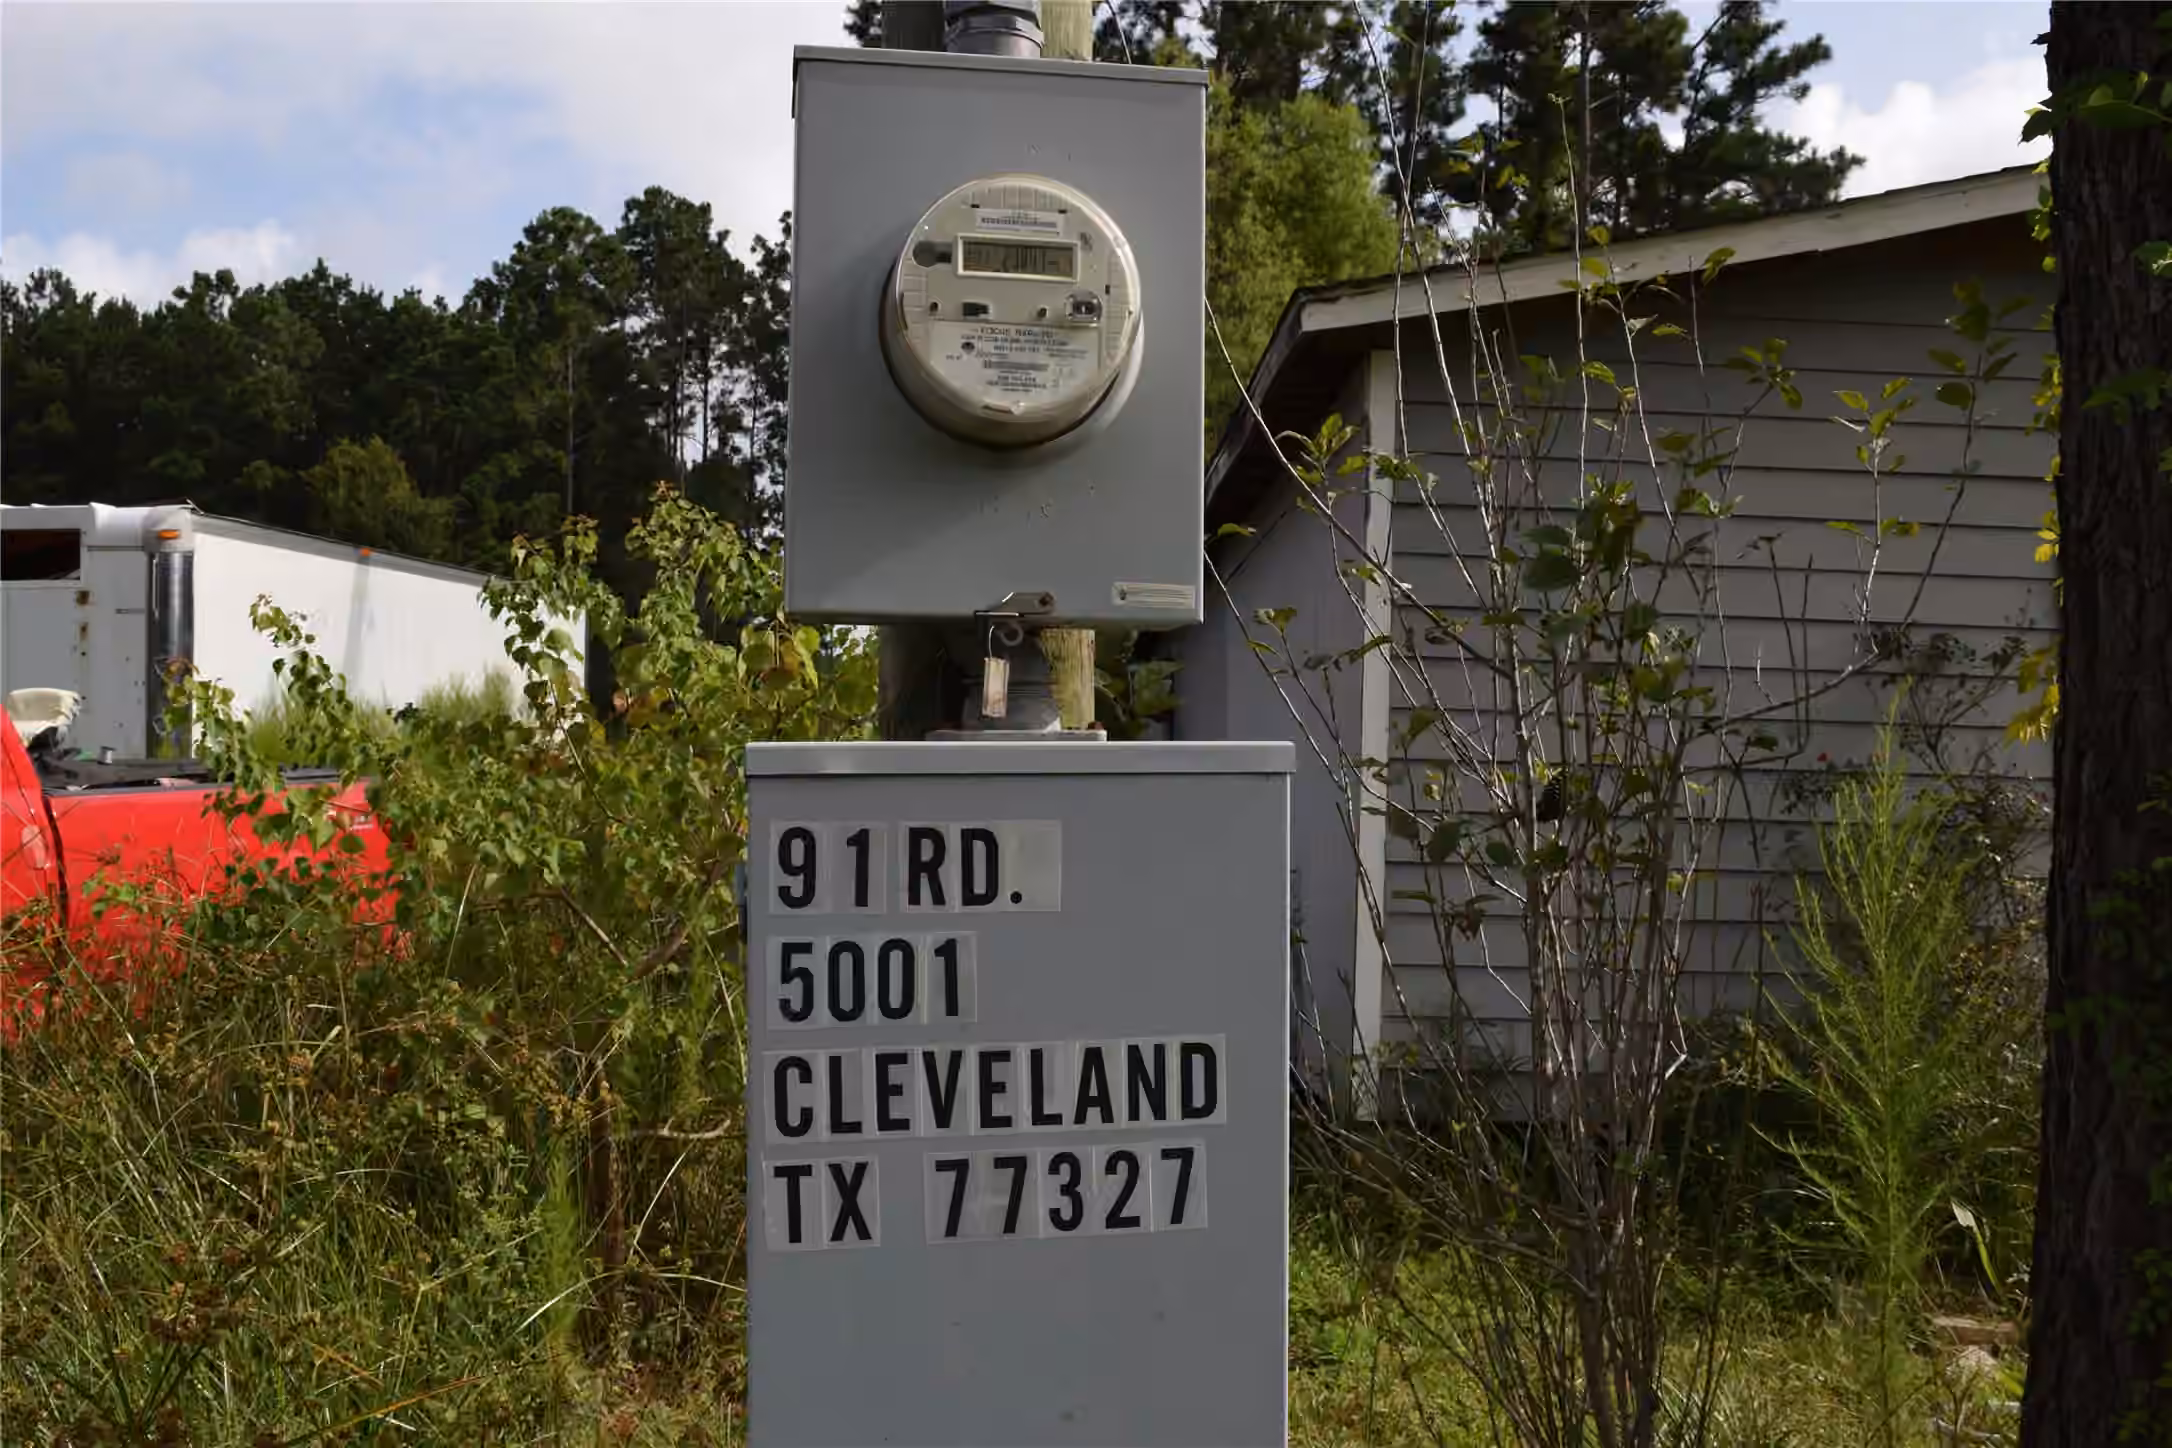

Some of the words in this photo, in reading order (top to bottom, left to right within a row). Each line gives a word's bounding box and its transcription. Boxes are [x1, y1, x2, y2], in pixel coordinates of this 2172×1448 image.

[777, 826, 870, 910] 91
[906, 827, 1023, 907] RD.
[777, 937, 959, 1023] 5001
[773, 1042, 1218, 1138] CLEVELAND
[773, 1161, 873, 1244] TX
[934, 1146, 1195, 1238] 77327
